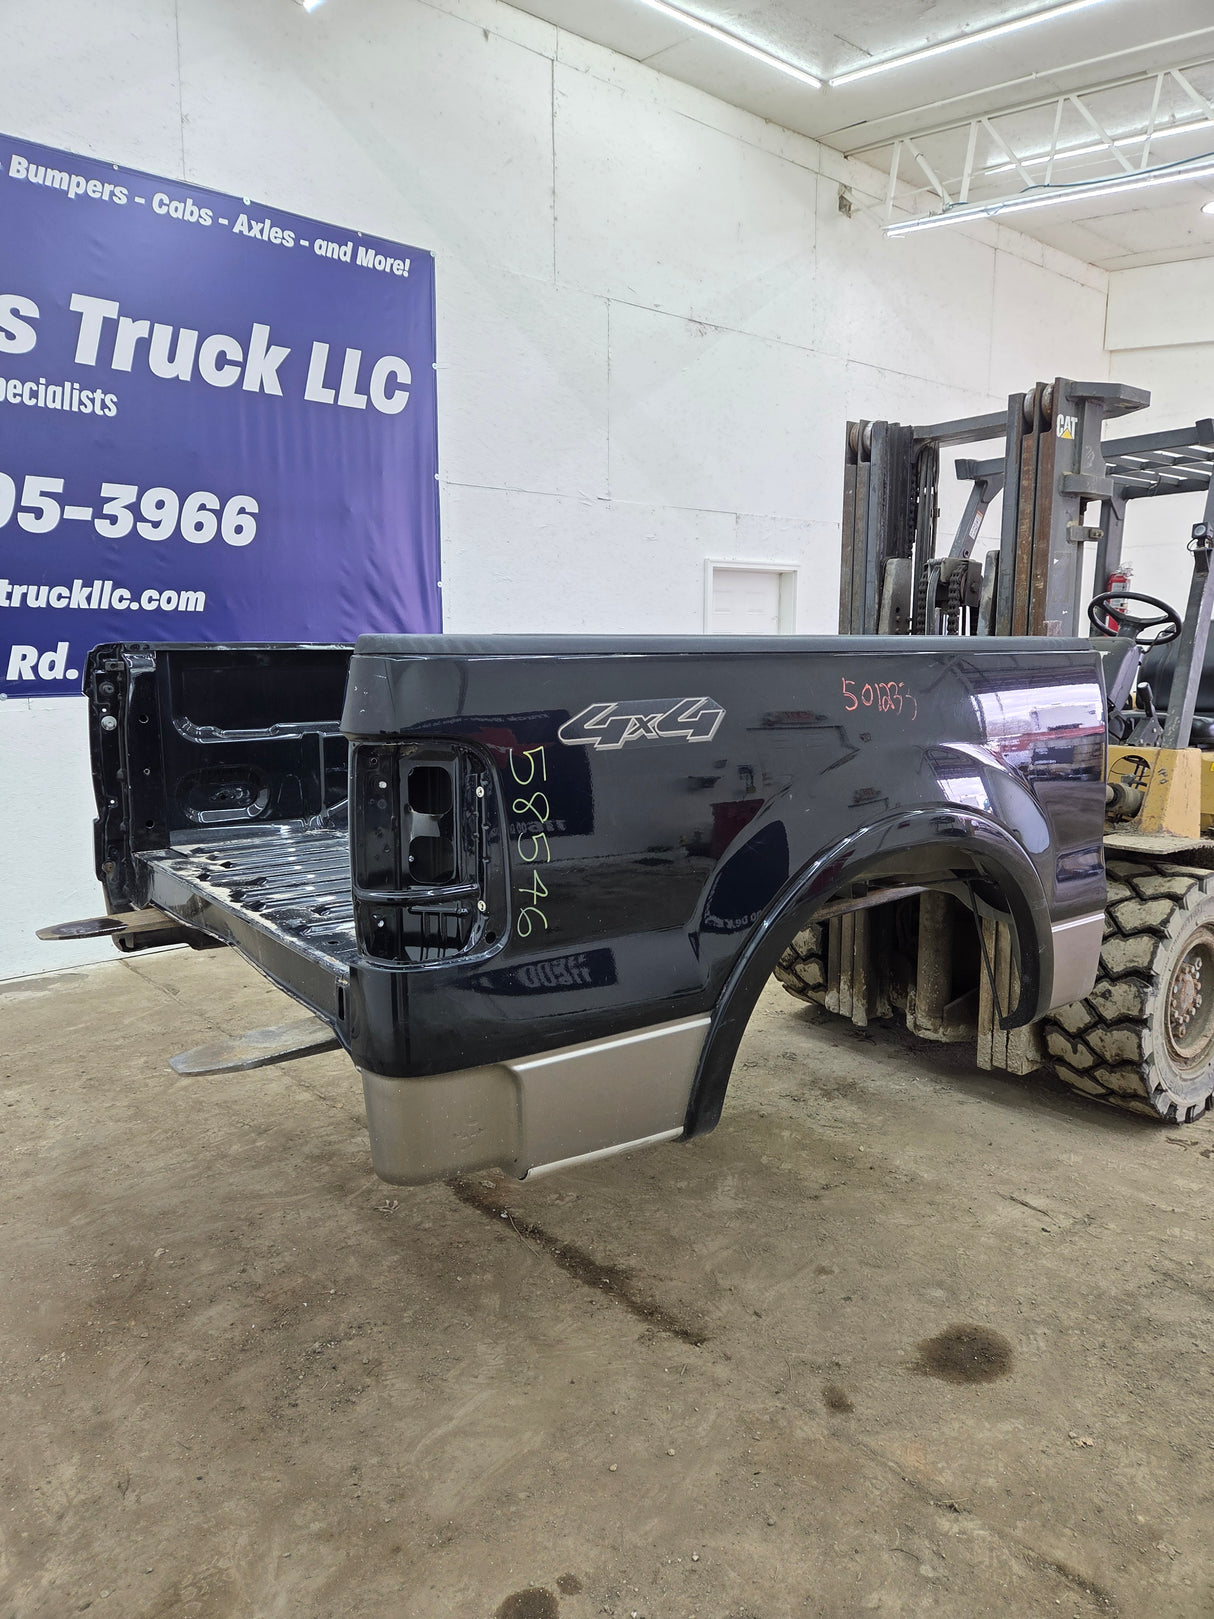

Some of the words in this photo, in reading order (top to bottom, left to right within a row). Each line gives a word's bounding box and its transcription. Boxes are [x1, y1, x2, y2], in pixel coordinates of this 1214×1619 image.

[8, 154, 128, 204] Bumpers
[152, 192, 214, 226] Cabs
[232, 213, 296, 248] Axles
[313, 238, 354, 263] and
[356, 246, 411, 278] More!
[69, 293, 292, 397] Truck
[303, 341, 412, 415] LLC
[1056, 413, 1079, 440] CAT
[0, 579, 206, 612] truckllc.com
[6, 641, 79, 681] Rd.
[558, 697, 726, 751] 4x4
[508, 745, 551, 938] 58546
